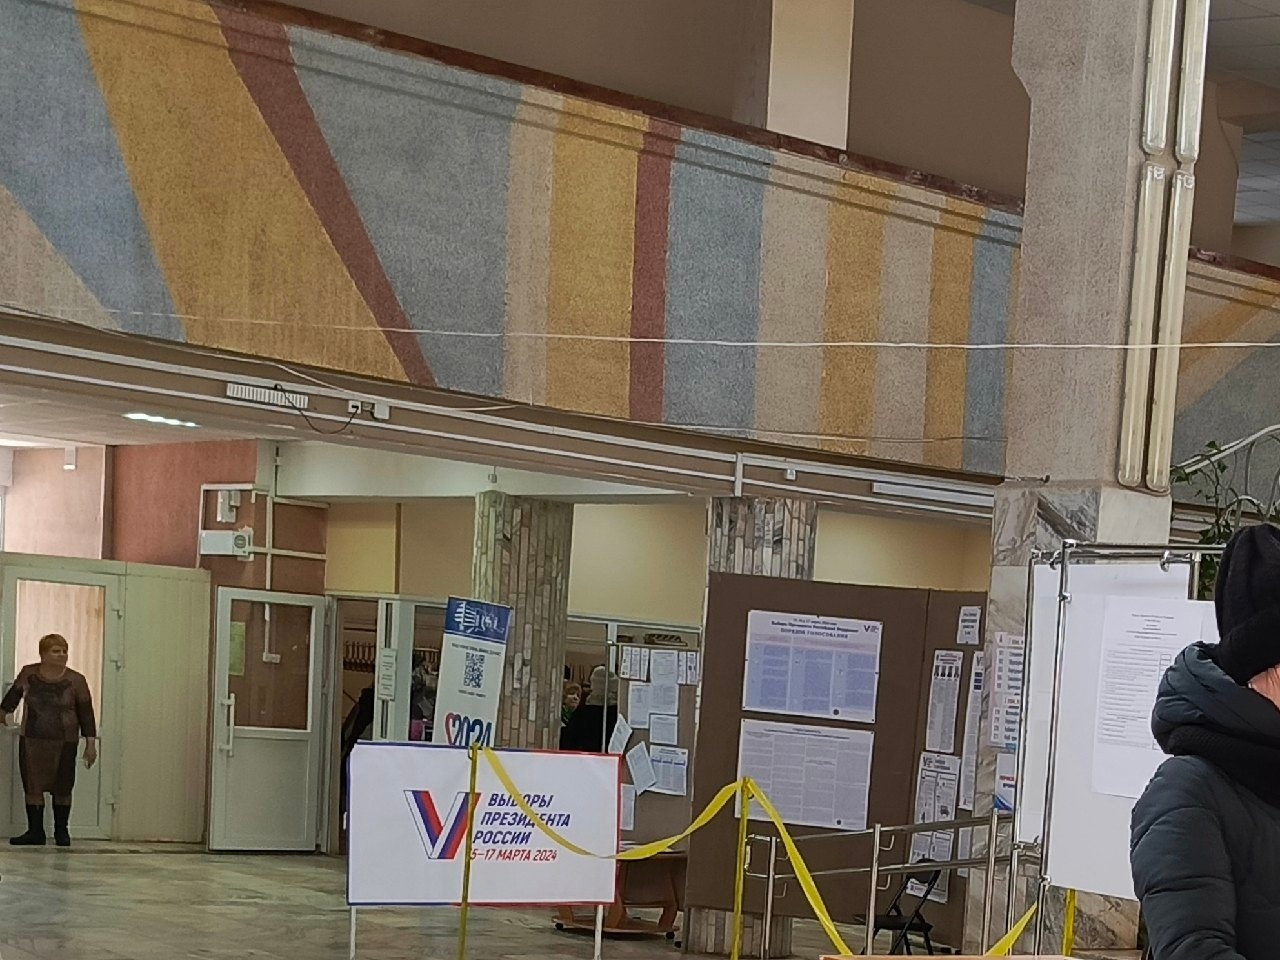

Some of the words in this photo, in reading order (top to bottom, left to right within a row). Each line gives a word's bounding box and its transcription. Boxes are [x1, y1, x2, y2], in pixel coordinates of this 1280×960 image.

[473, 831, 532, 845] РОССИИ
[497, 849, 530, 861] МАРТА
[533, 850, 558, 861] 2024
